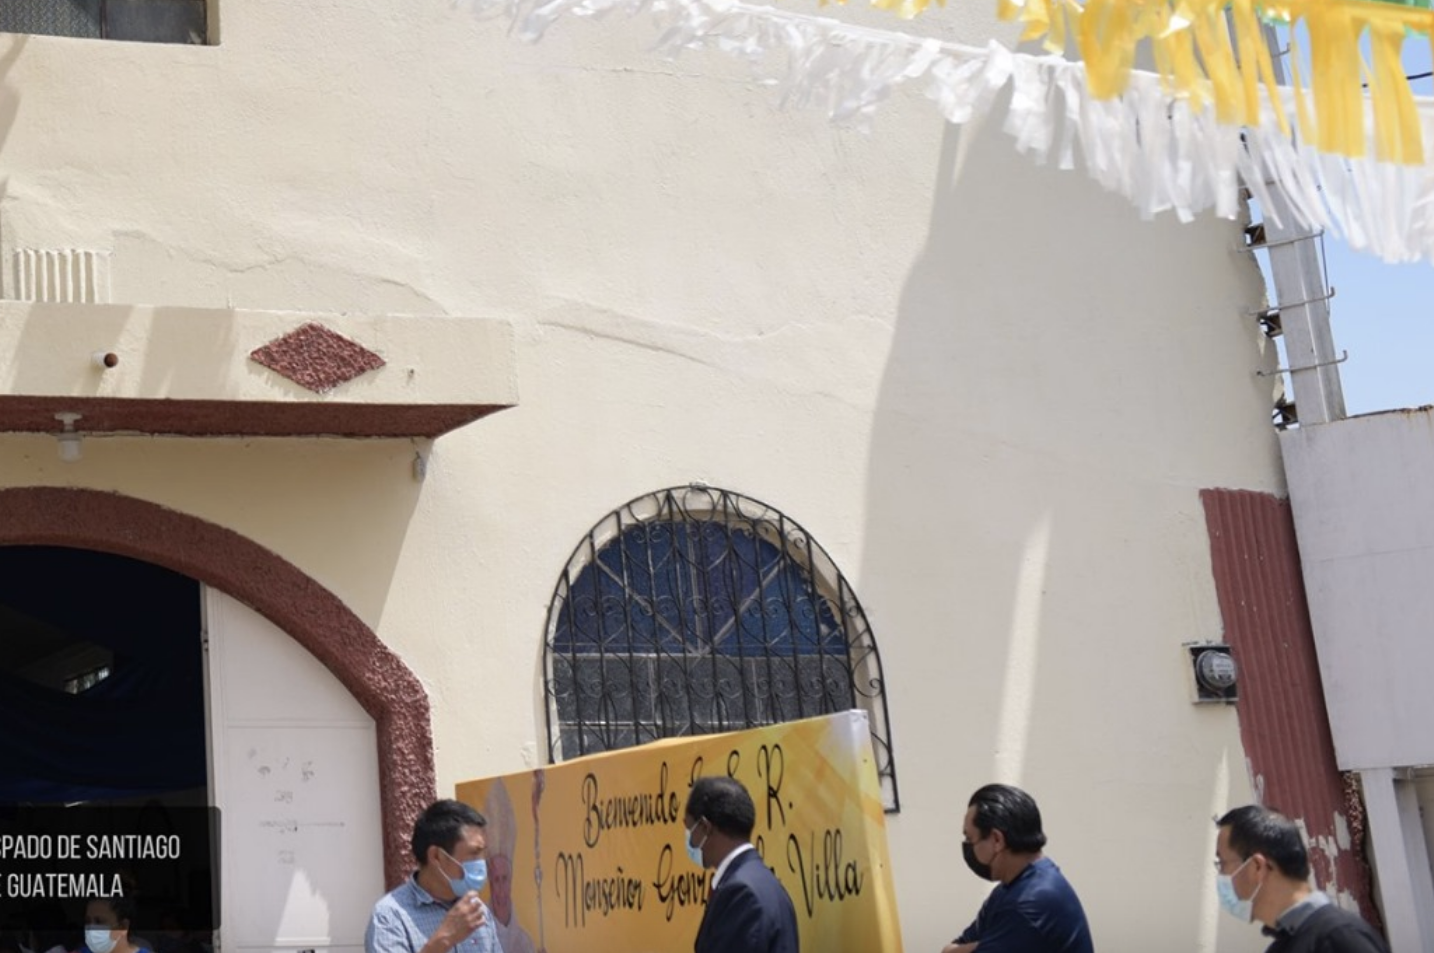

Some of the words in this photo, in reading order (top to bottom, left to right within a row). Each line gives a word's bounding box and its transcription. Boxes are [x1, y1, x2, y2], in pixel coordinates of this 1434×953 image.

[581, 761, 680, 848] Bienvenido
[555, 851, 645, 928] Monseñor
[652, 843, 714, 922] Gonz
[786, 828, 865, 918] Villa
